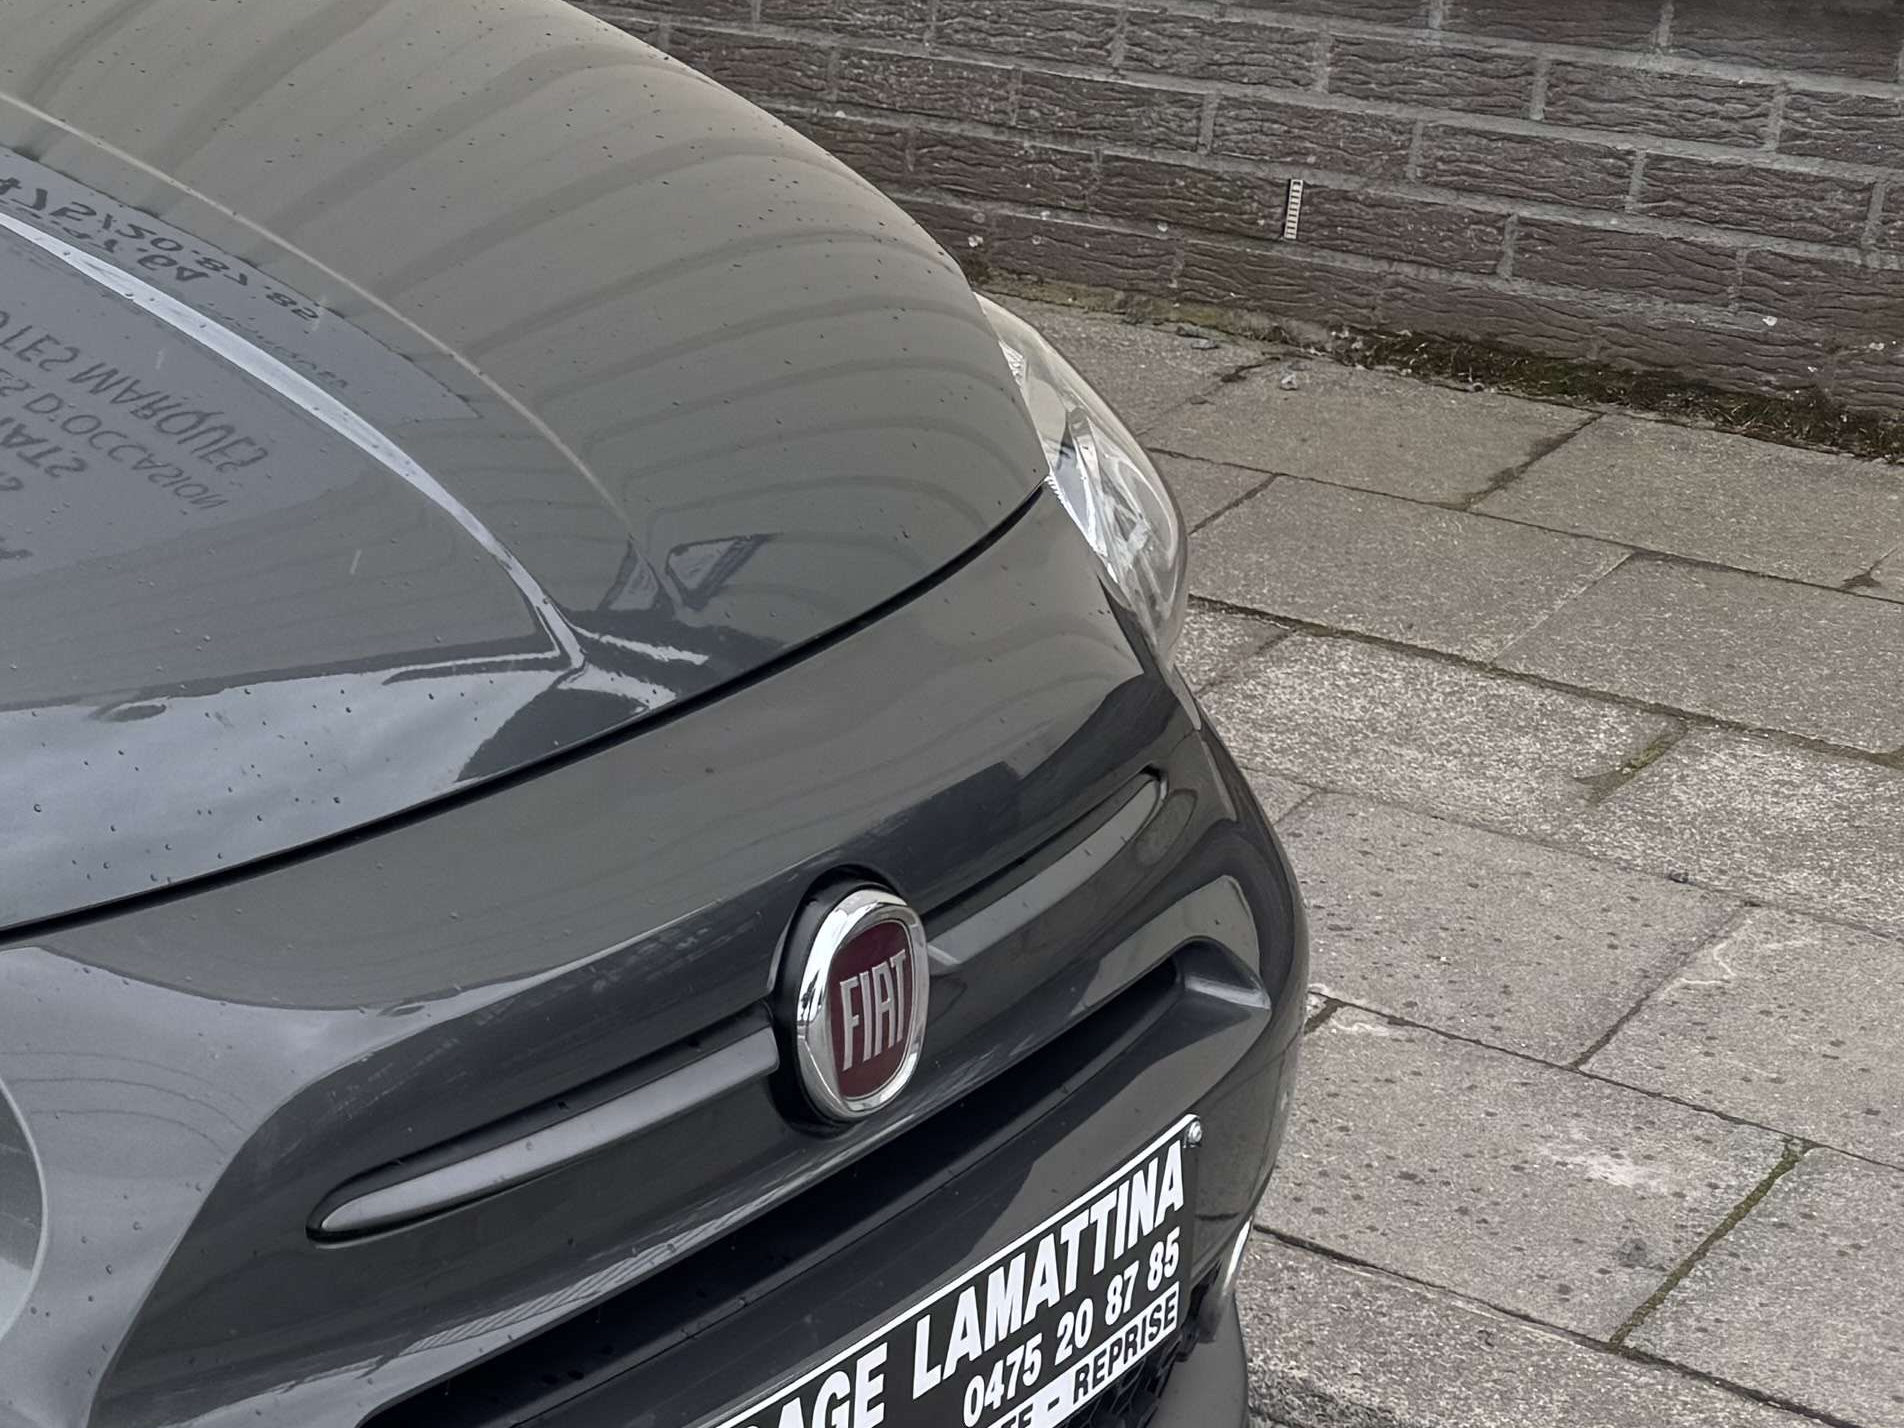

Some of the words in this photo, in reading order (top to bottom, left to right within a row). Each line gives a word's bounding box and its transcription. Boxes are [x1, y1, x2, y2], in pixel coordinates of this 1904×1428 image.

[837, 949, 914, 1072] FIAT
[912, 1138, 1185, 1401] LAMATTINA
[963, 1331, 1043, 1428] 0475
[1054, 1297, 1094, 1367] 20
[1104, 1259, 1141, 1326] 87
[1146, 1225, 1181, 1292] 85
[1072, 1287, 1179, 1406] REPRISE
